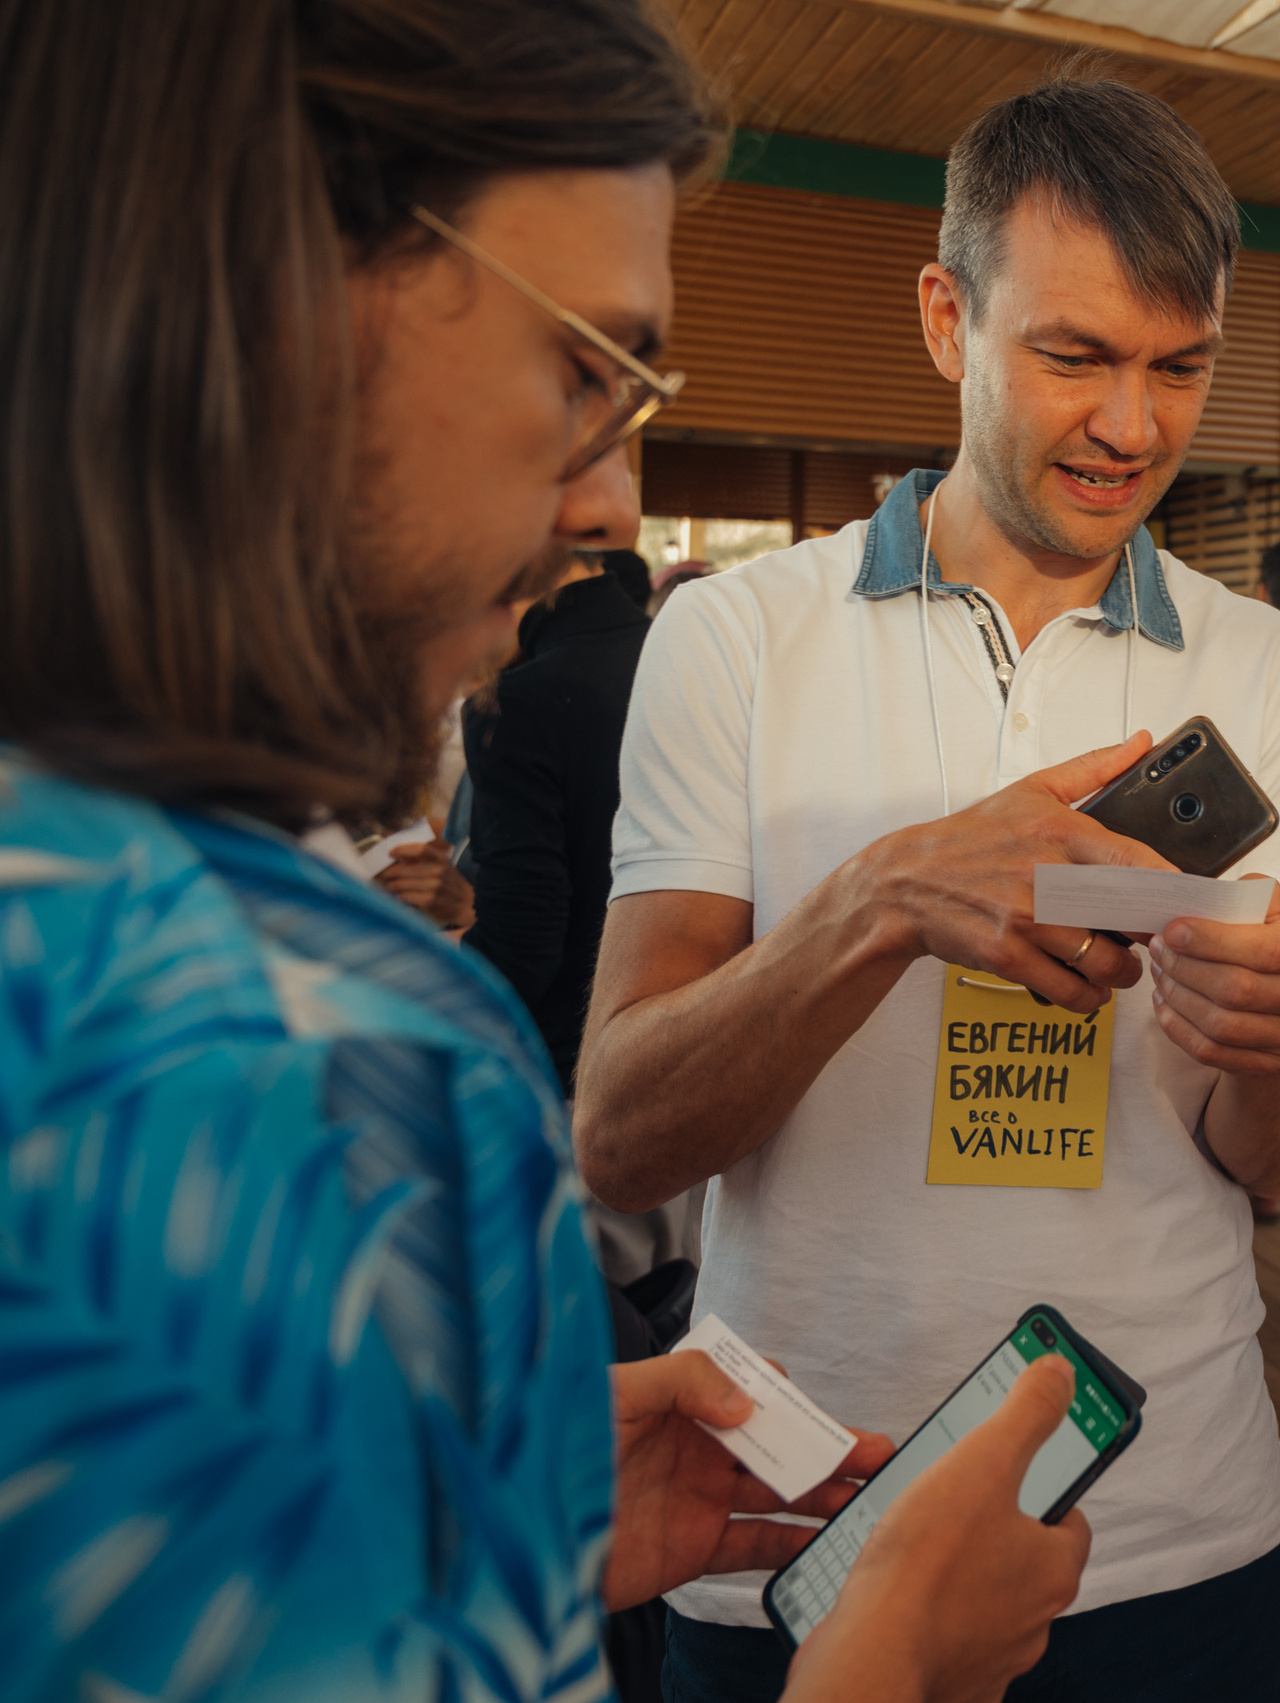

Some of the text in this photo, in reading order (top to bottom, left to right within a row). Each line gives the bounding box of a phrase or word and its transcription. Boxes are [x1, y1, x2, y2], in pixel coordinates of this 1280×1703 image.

[948, 1009, 1100, 1056] ЕВГЕНИЙ
[950, 1064, 1069, 1104] БЯКИН
[950, 1126, 1095, 1161] VANLIFE
